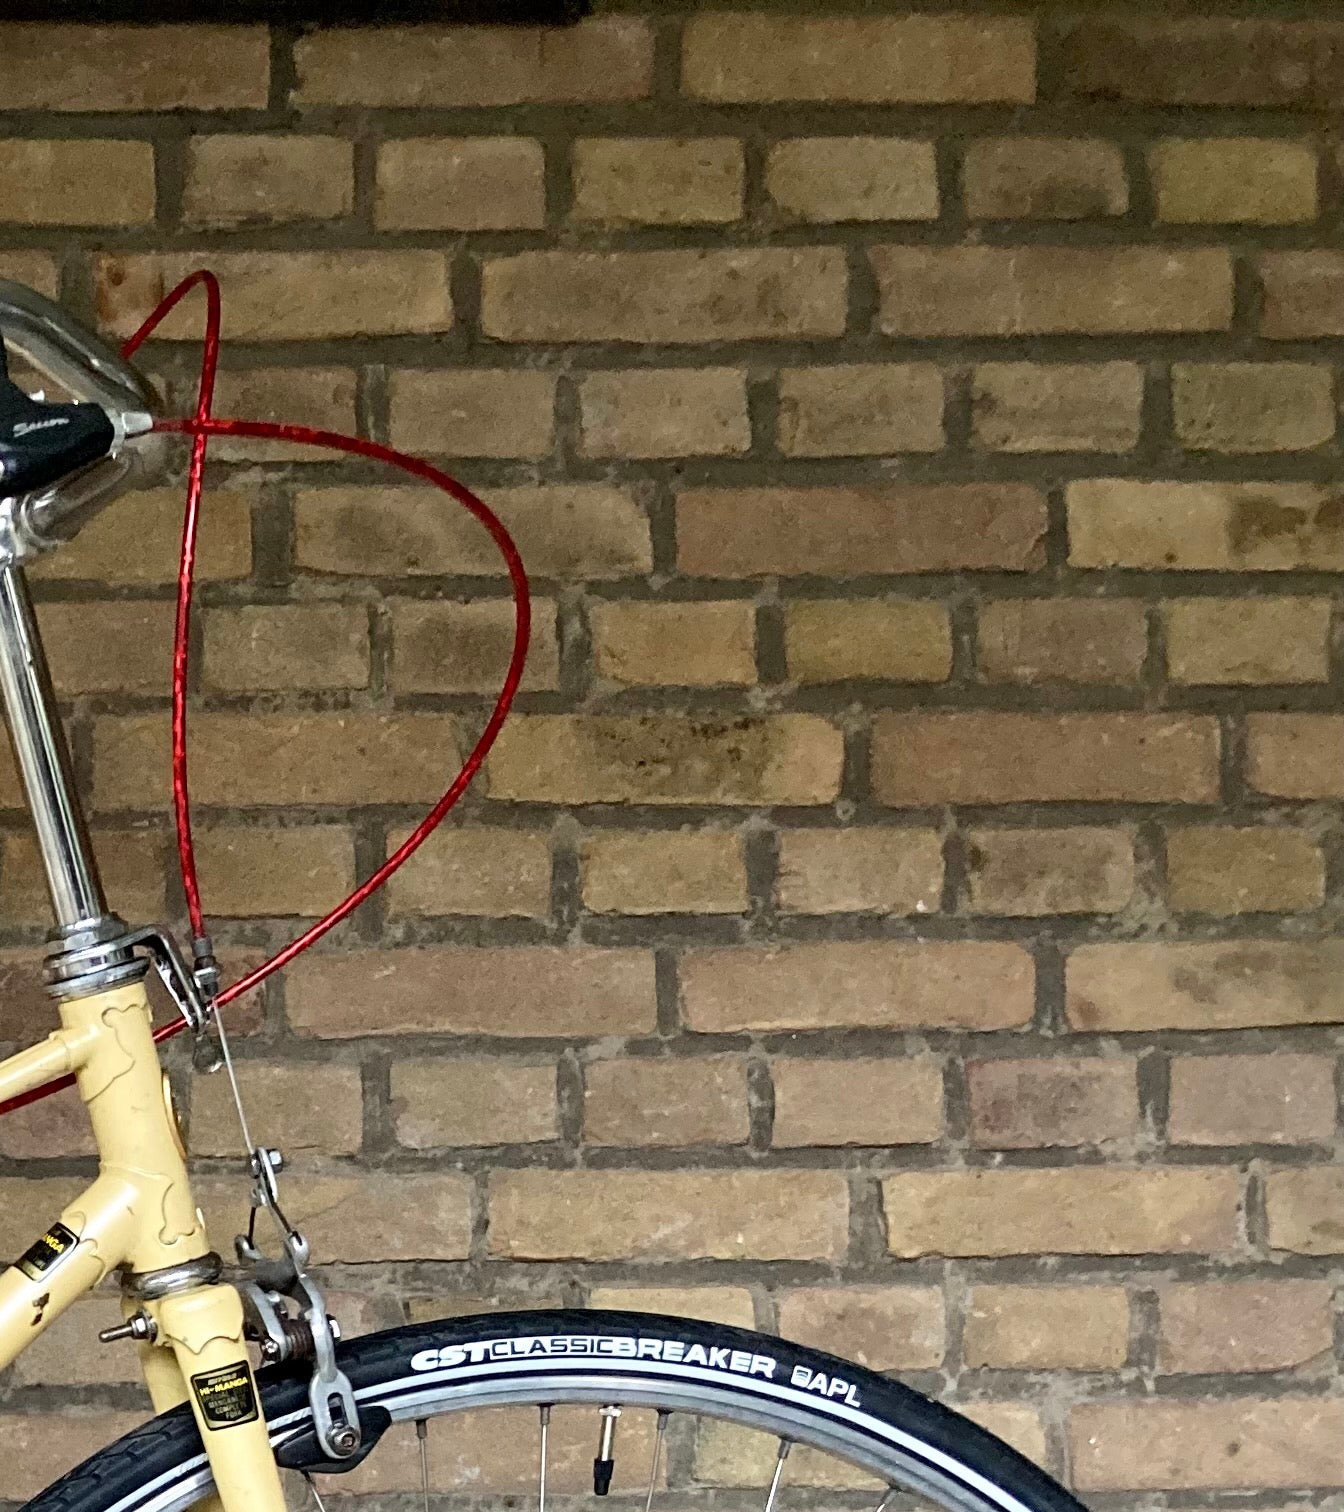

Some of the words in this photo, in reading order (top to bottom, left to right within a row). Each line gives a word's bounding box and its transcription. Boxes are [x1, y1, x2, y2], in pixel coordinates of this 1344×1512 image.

[410, 1341, 490, 1371] CST
[491, 1337, 614, 1357] CLASSIC
[614, 1337, 777, 1379] BREAKER
